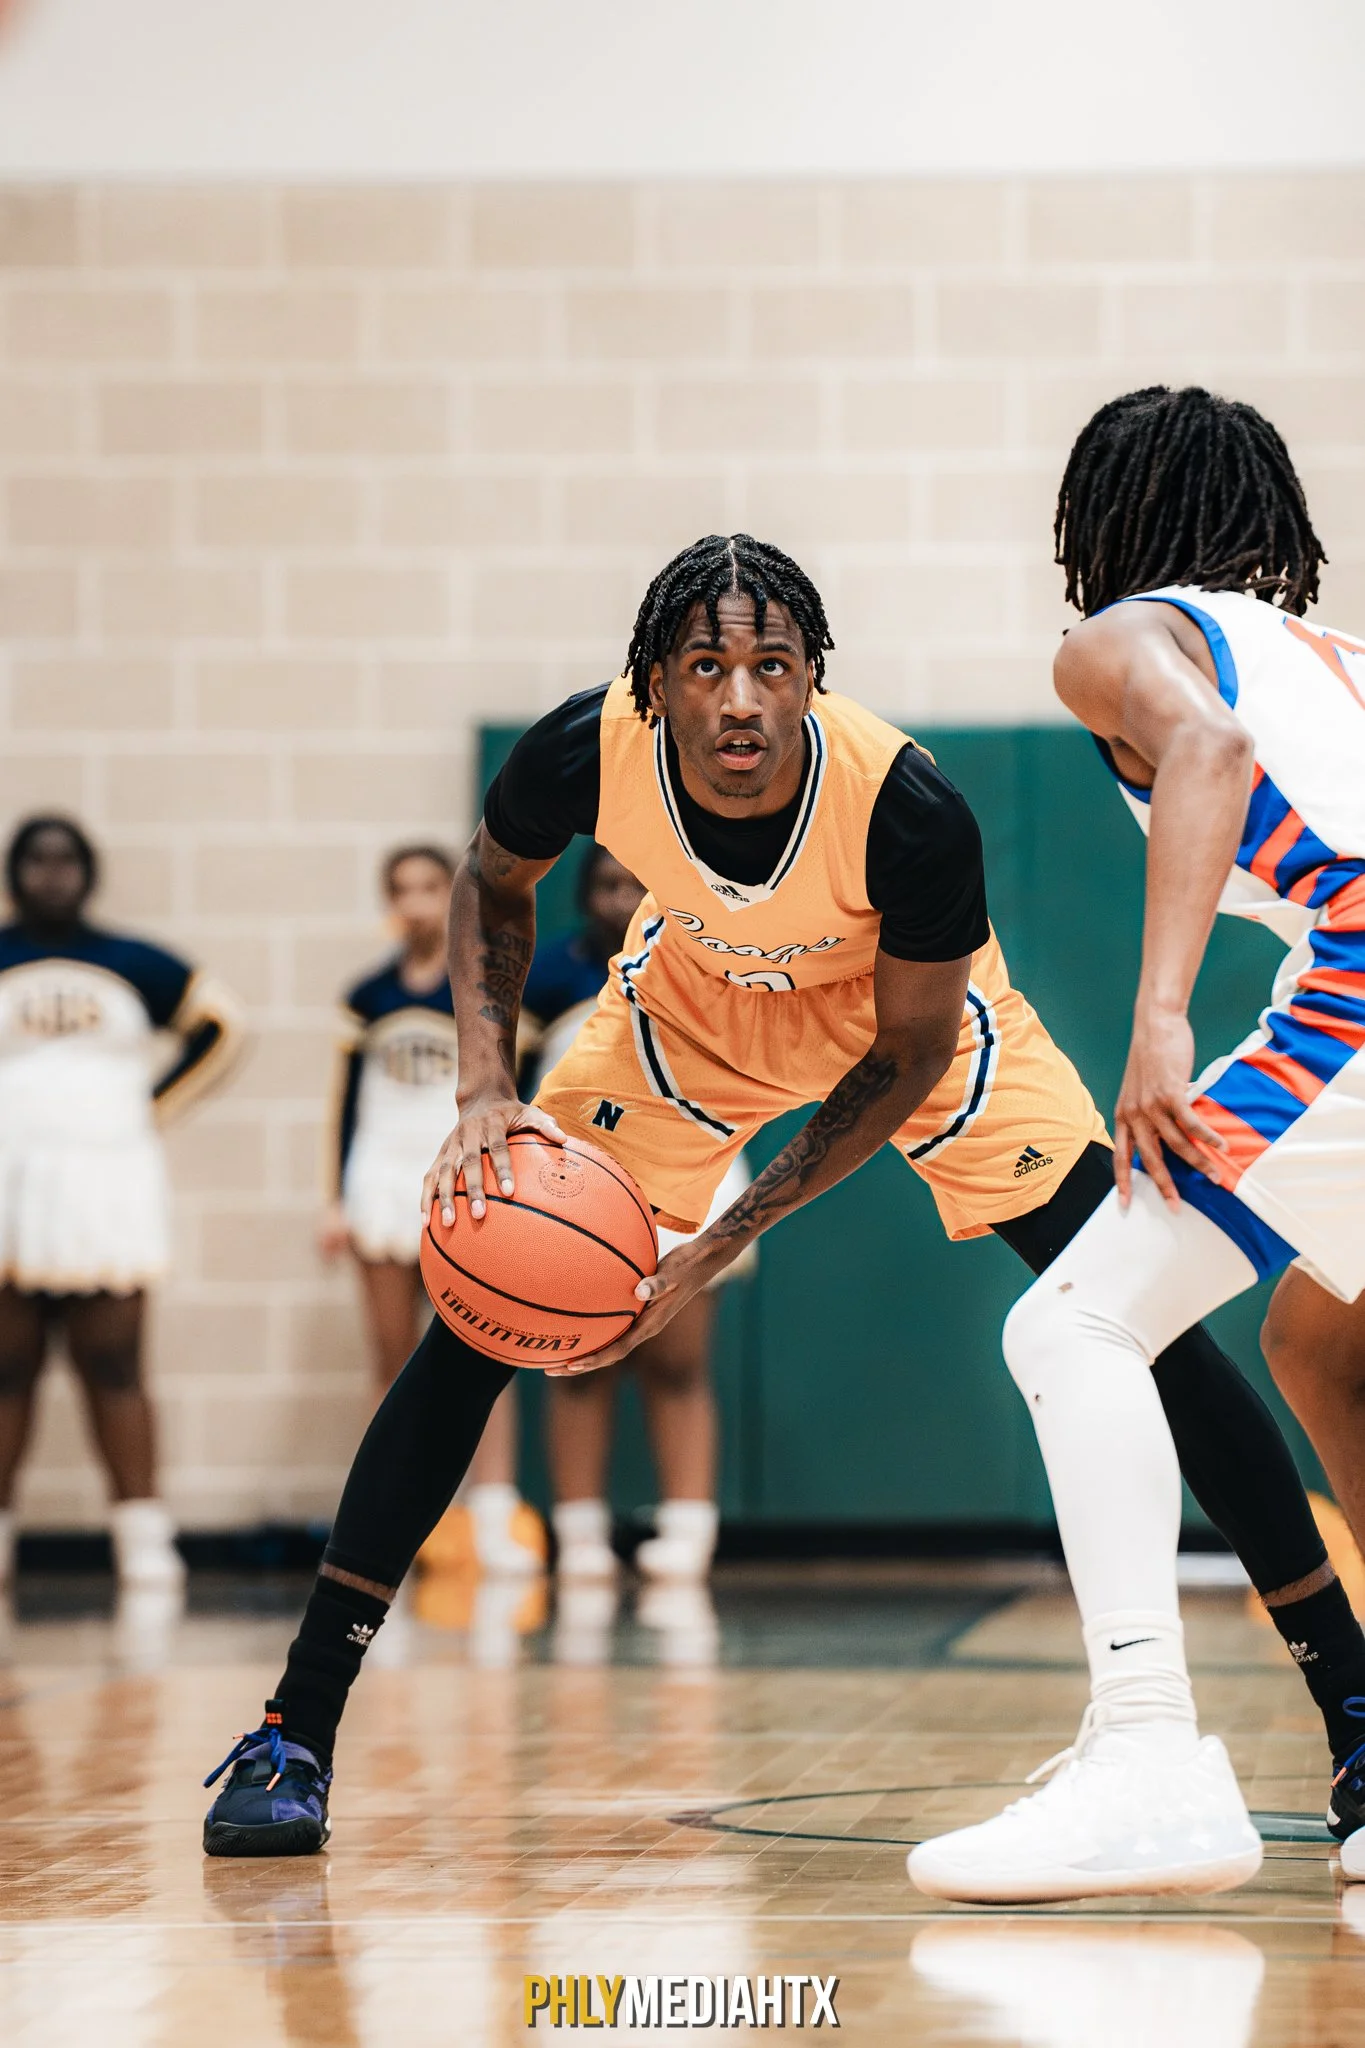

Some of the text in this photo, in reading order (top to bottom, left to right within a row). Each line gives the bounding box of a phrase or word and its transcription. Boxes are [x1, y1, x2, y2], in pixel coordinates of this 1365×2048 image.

[592, 1099, 624, 1132] N
[1013, 1157, 1053, 1178] adidas
[440, 1289, 581, 1351] EVOLUTION
